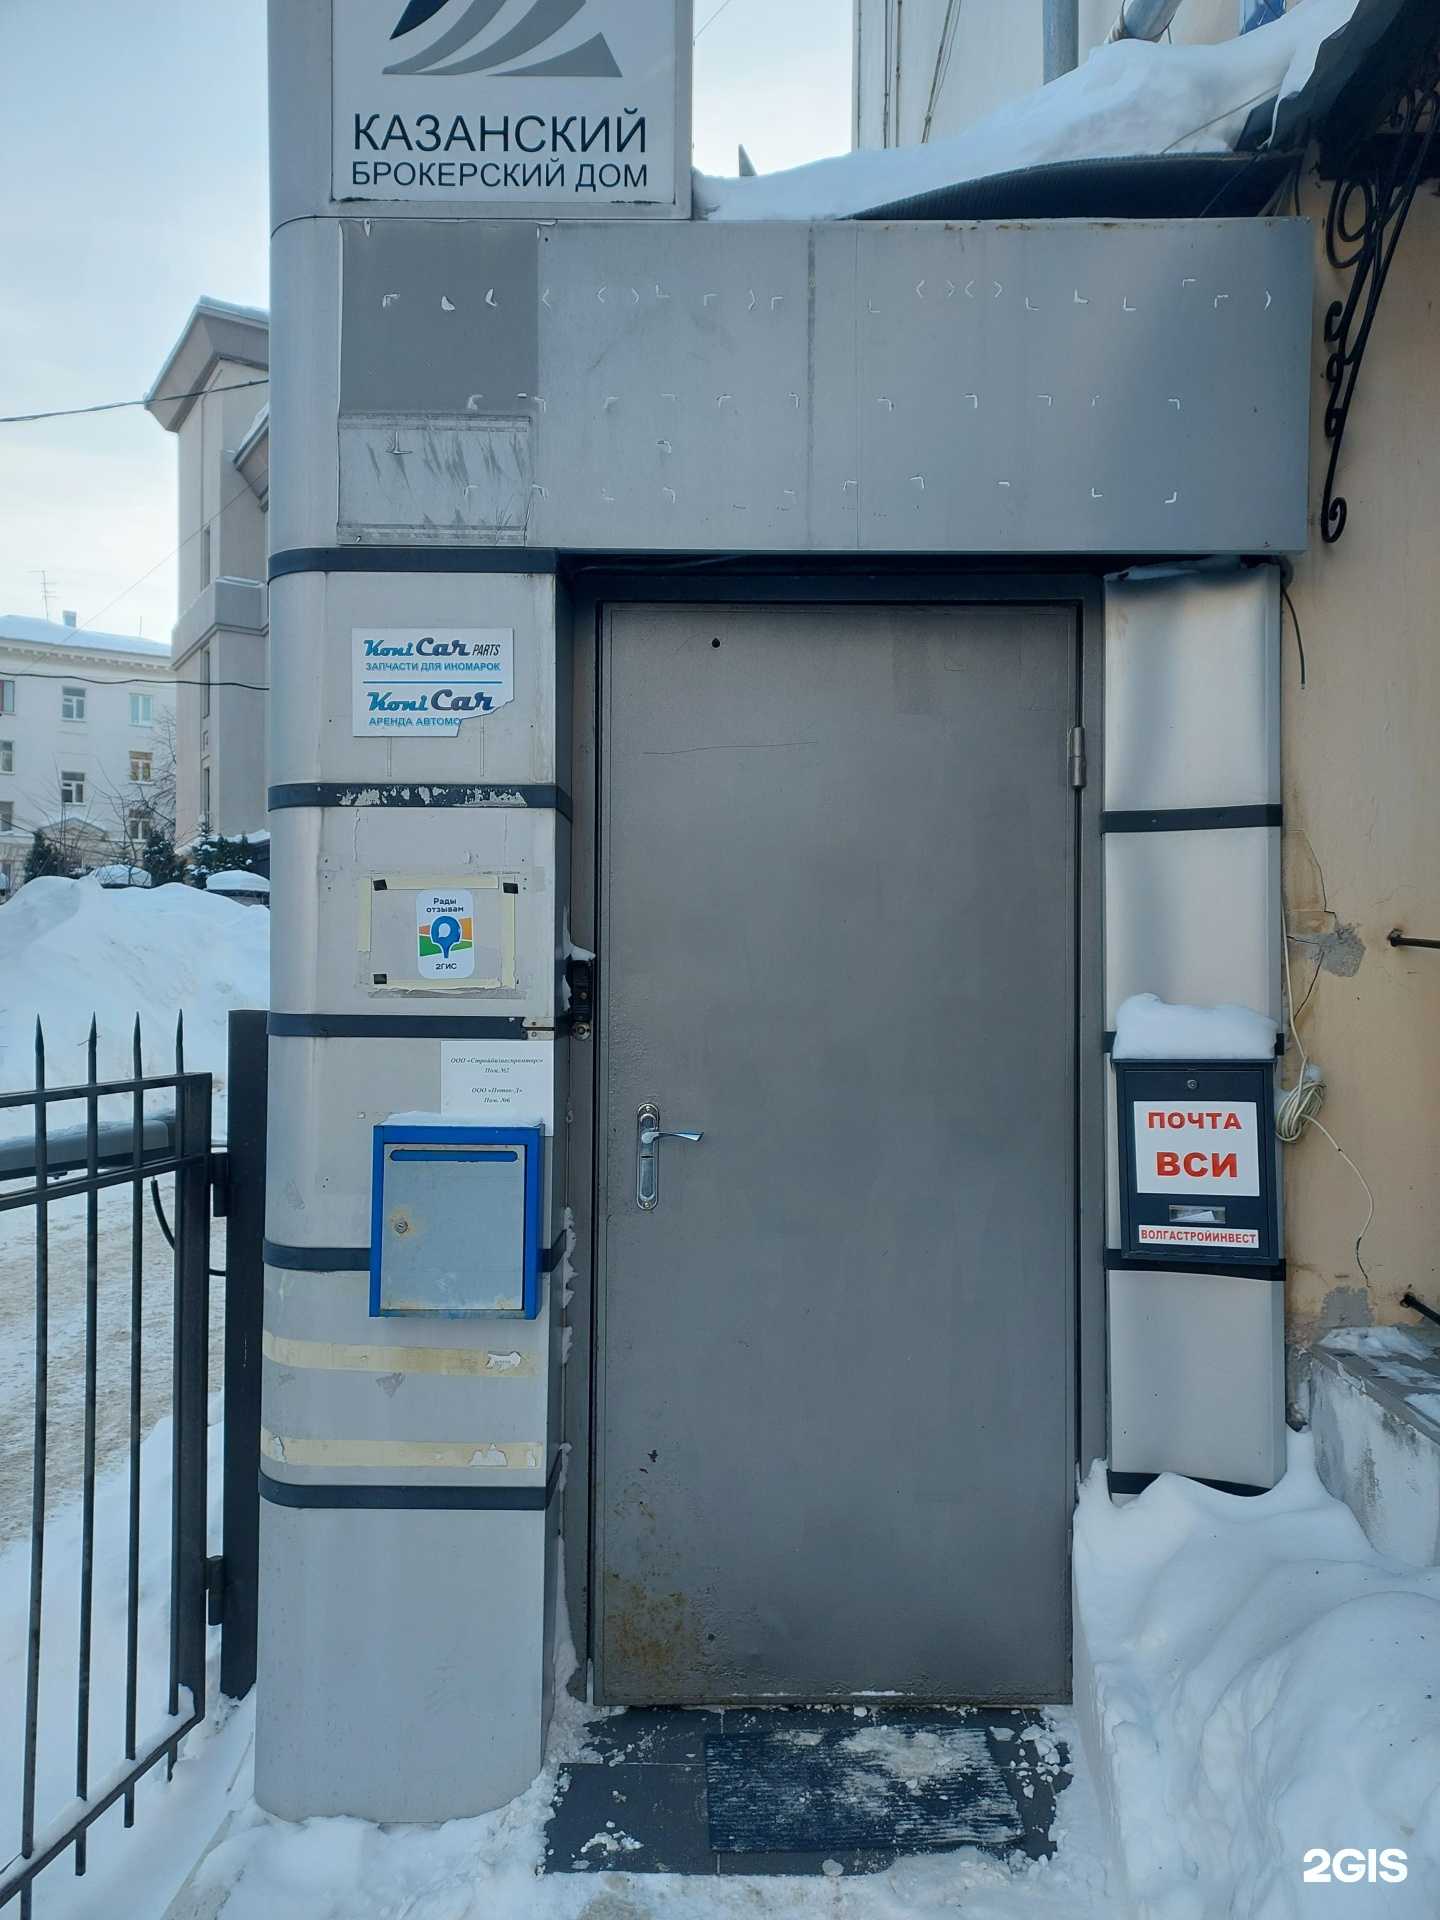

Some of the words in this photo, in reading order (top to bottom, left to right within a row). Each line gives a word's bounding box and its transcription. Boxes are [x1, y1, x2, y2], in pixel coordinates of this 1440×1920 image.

[354, 107, 647, 153] КАЗАНСКИЙ
[351, 157, 565, 187] БРОКЕРСКИЙ
[574, 163, 648, 192] ДОМ
[363, 639, 414, 657] Koni
[415, 637, 471, 657] Car
[472, 644, 501, 656] PARTS
[365, 662, 419, 672] ЗАПЧАСТИ
[420, 662, 443, 673] ДЛЯ
[444, 662, 502, 672] ИНОМАРОК
[367, 691, 429, 712] Koni
[430, 688, 496, 712] Car
[369, 717, 413, 728] АРЕНДА
[433, 897, 457, 906] Рады
[1148, 1111, 1243, 1130] ПОЧТА
[1156, 1151, 1238, 1178] ВСИ
[1140, 1229, 1257, 1244] ВОЛГАСТРОЙИНВЕСТ
